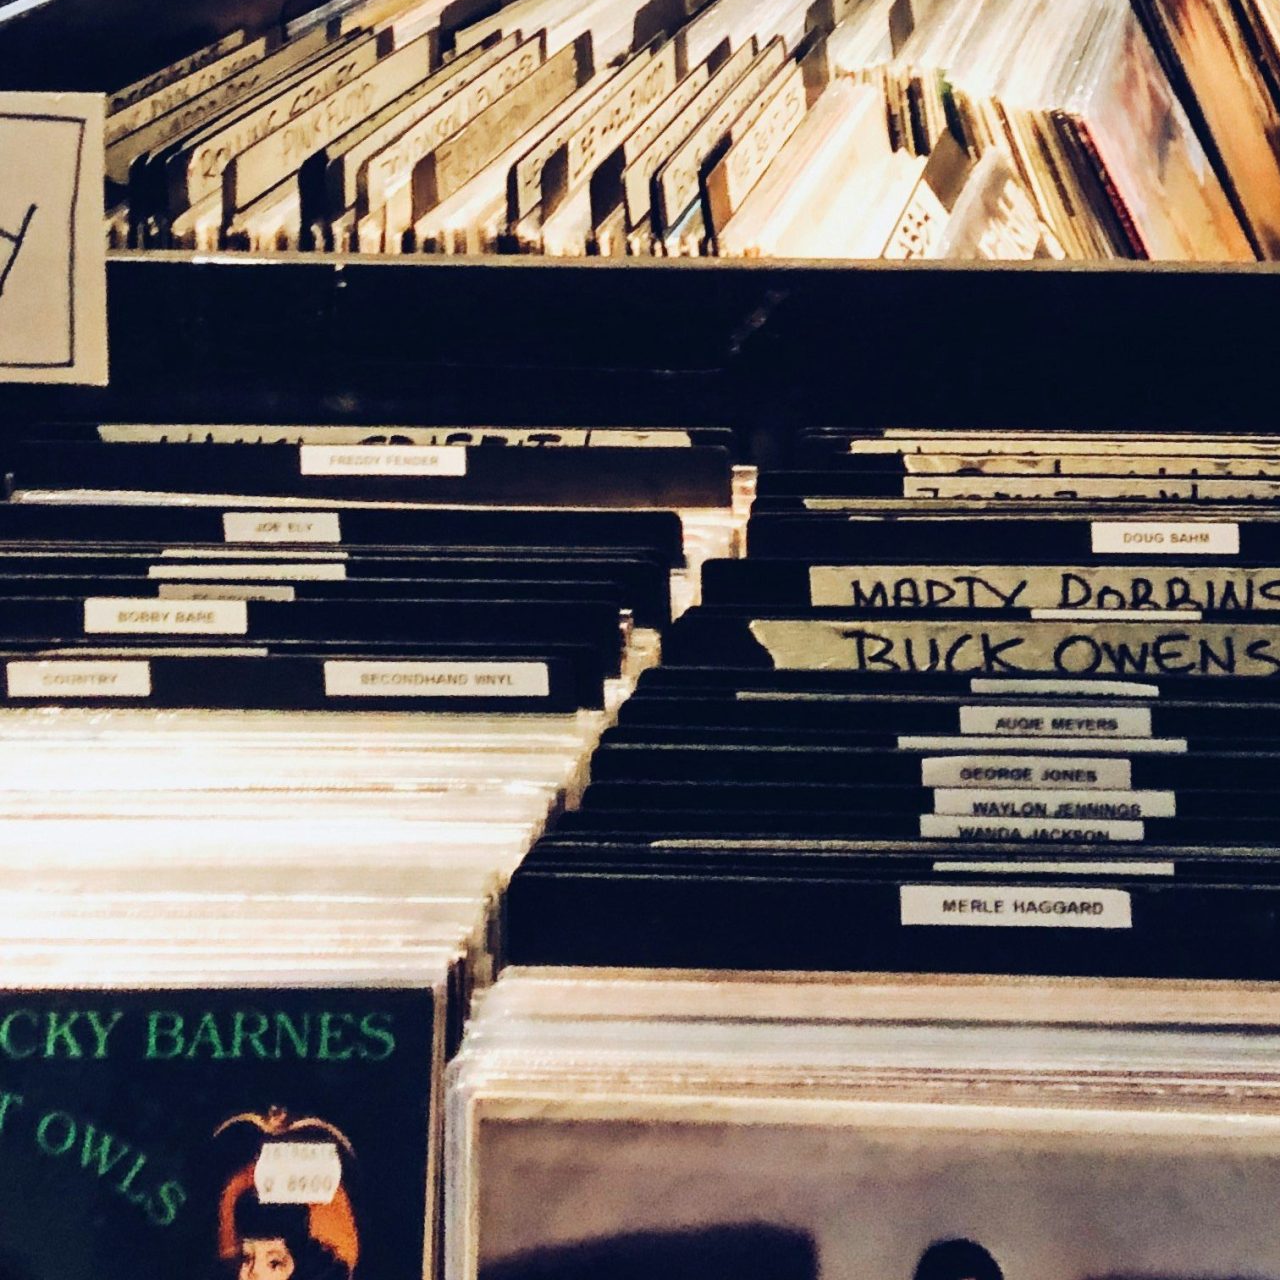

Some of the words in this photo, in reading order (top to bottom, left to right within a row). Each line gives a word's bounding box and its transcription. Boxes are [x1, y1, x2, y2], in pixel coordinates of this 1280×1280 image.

[386, 455, 438, 467] FENDER
[1123, 532, 1164, 544] DOUG
[1170, 533, 1210, 544] SAHM
[117, 610, 170, 624] BOBBY
[175, 611, 215, 624] BARE
[840, 629, 1025, 671] BUCK
[360, 674, 468, 686] SECONDHAND
[474, 674, 513, 686] VINYL
[995, 717, 1043, 731] AUGIE
[1051, 718, 1118, 731] MEYERS
[959, 767, 1033, 781] GEORGE
[1041, 768, 1098, 782] JONES
[972, 802, 1047, 817] WAYLON
[1055, 803, 1142, 818] JENNINGS
[1032, 827, 1110, 840] JACKSON
[942, 899, 1004, 914] MERLE
[1013, 900, 1104, 915] HAGGARD
[144, 1009, 397, 1061] BARNES
[36, 1111, 187, 1227] OWLS
